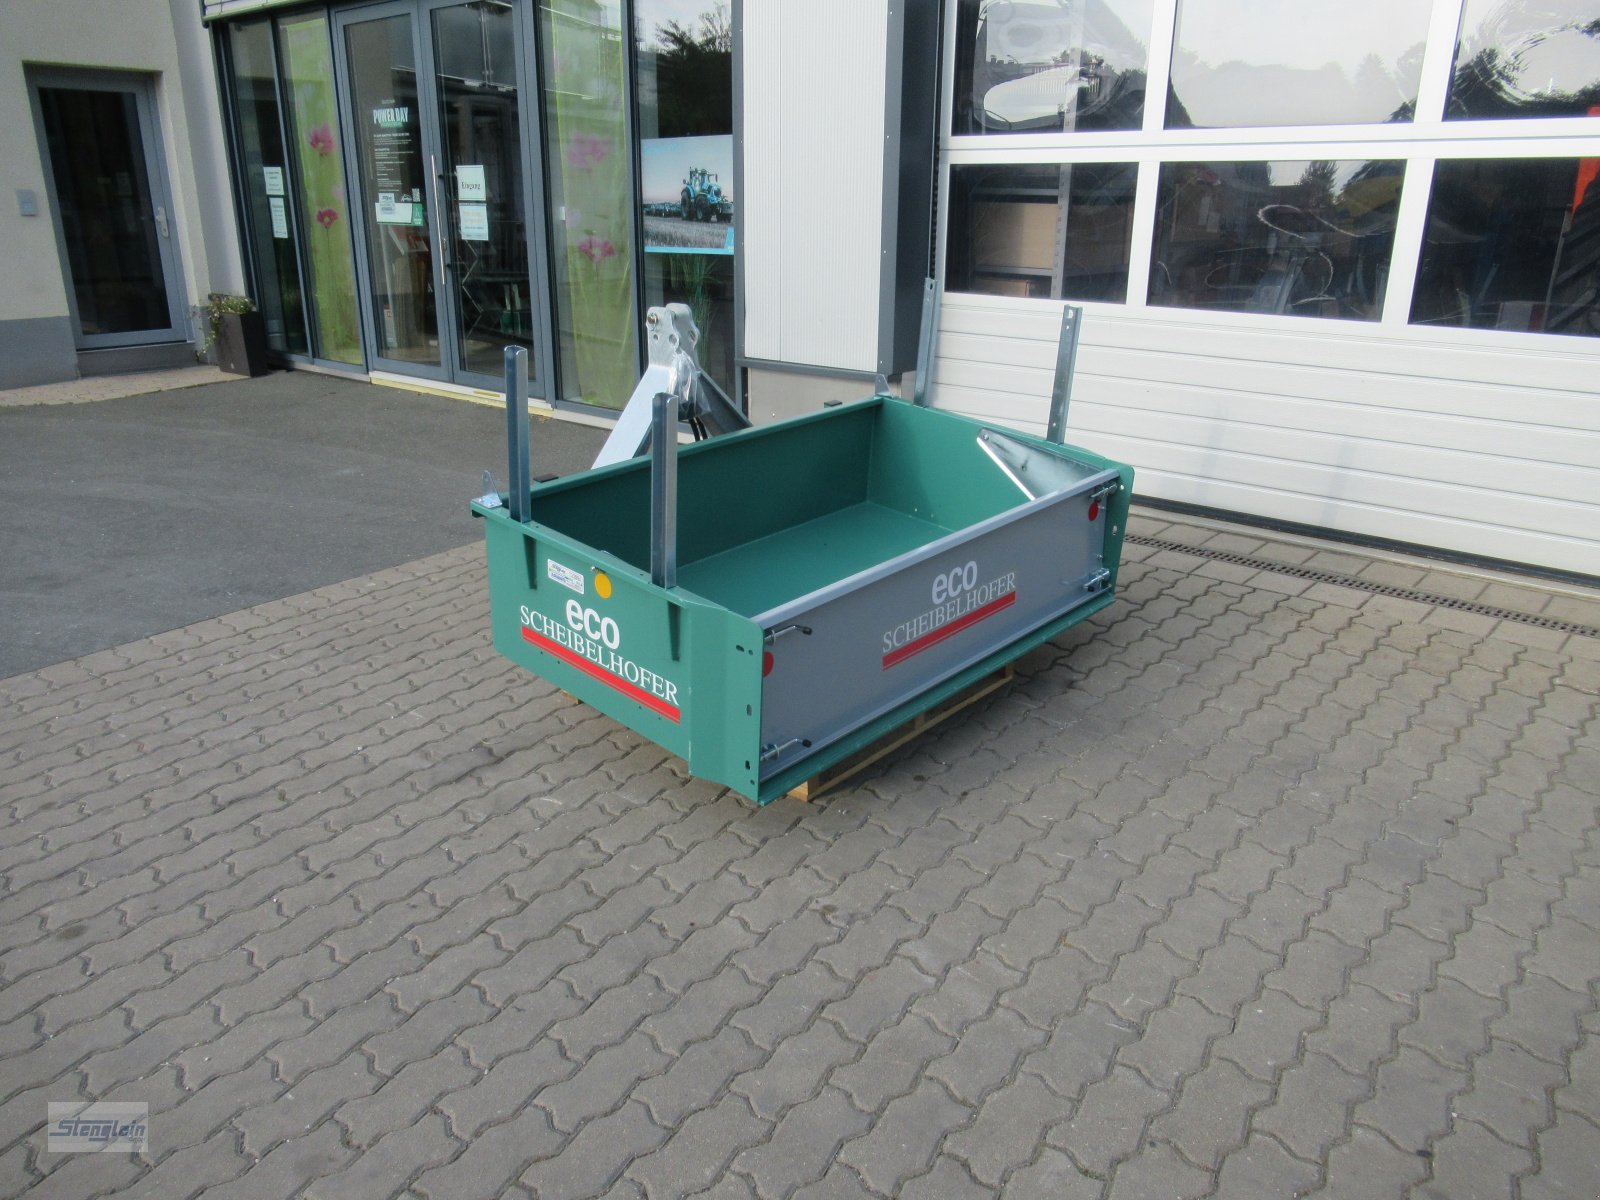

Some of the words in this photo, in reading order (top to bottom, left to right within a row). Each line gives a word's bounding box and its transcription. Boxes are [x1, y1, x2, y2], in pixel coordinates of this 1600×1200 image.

[461, 182, 481, 190] Eingang
[931, 560, 978, 605] eco
[565, 599, 620, 650] eco
[882, 572, 1016, 653] SCHEIBELHOFER
[520, 605, 680, 706] SCHEIBELHOFER
